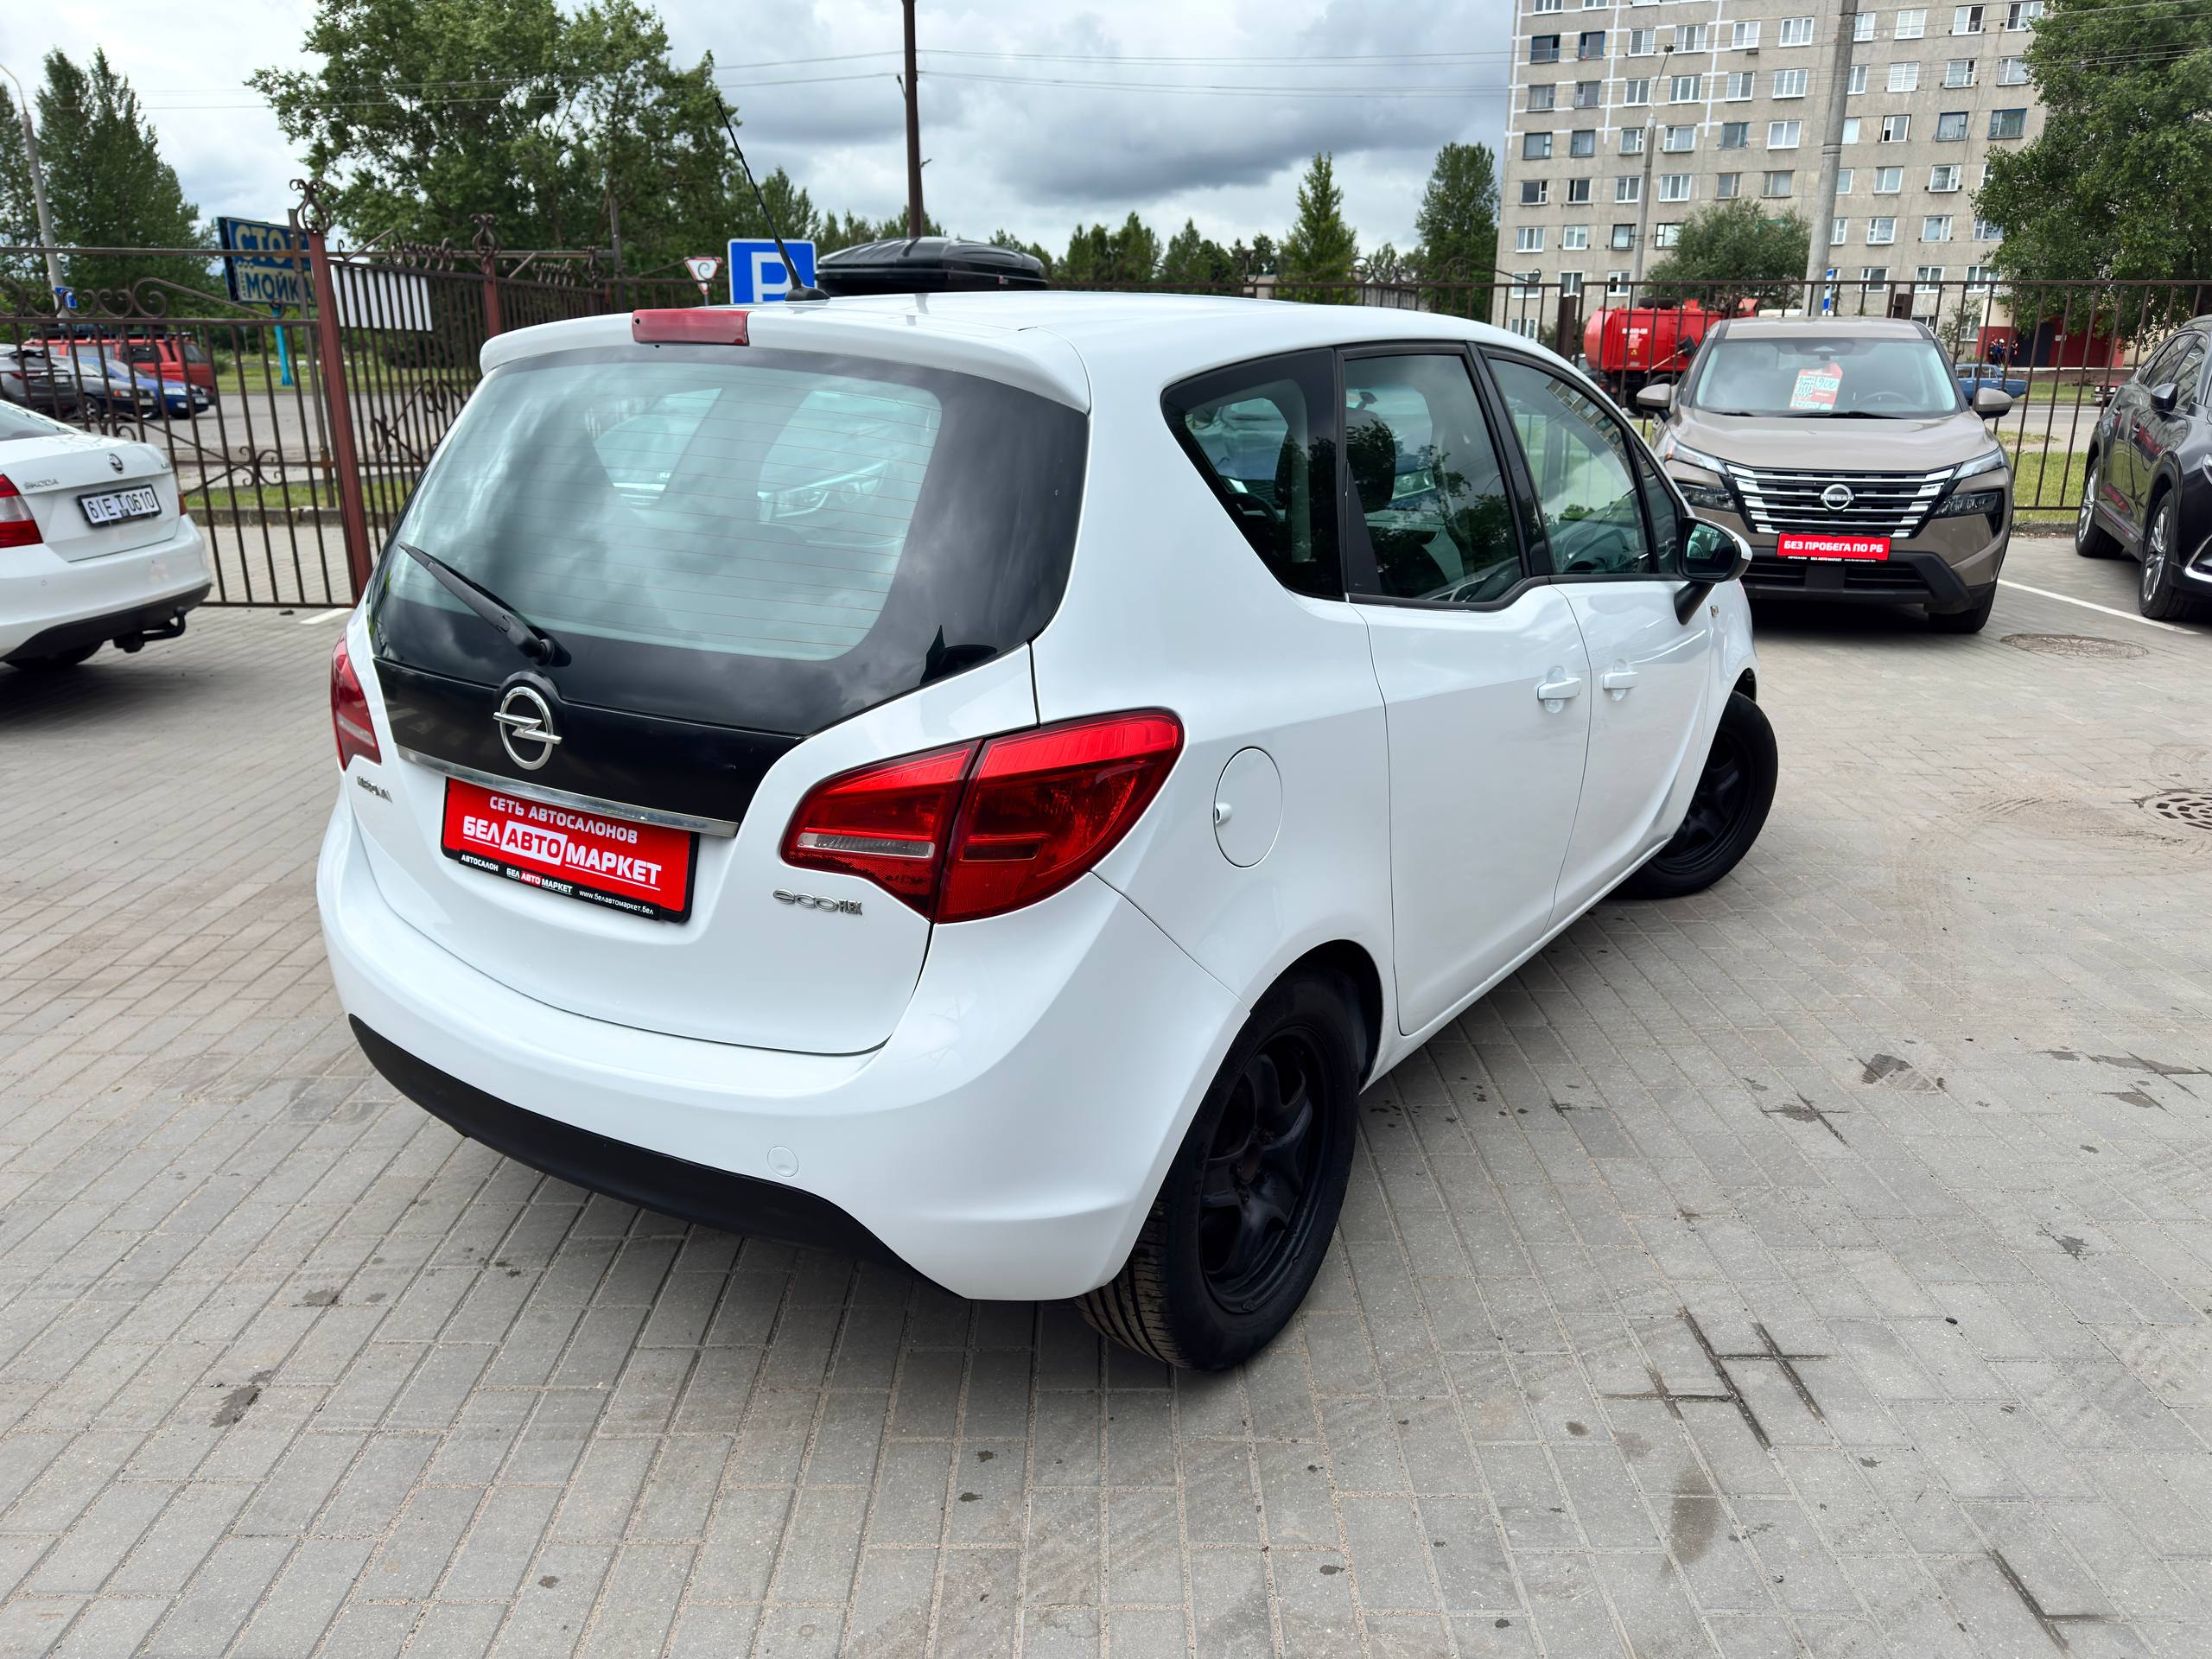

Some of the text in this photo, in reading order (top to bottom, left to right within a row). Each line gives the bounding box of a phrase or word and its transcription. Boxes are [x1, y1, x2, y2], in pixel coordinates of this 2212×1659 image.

[1783, 540, 1884, 553] БЕЗ ПРОБЕГА ПО РБ
[489, 796, 638, 844] СЕТЬ АВТОСАЛОНОВ
[461, 854, 499, 872] АВТОСАЛОН
[579, 890, 654, 915] www.белавтомаркет.бел
